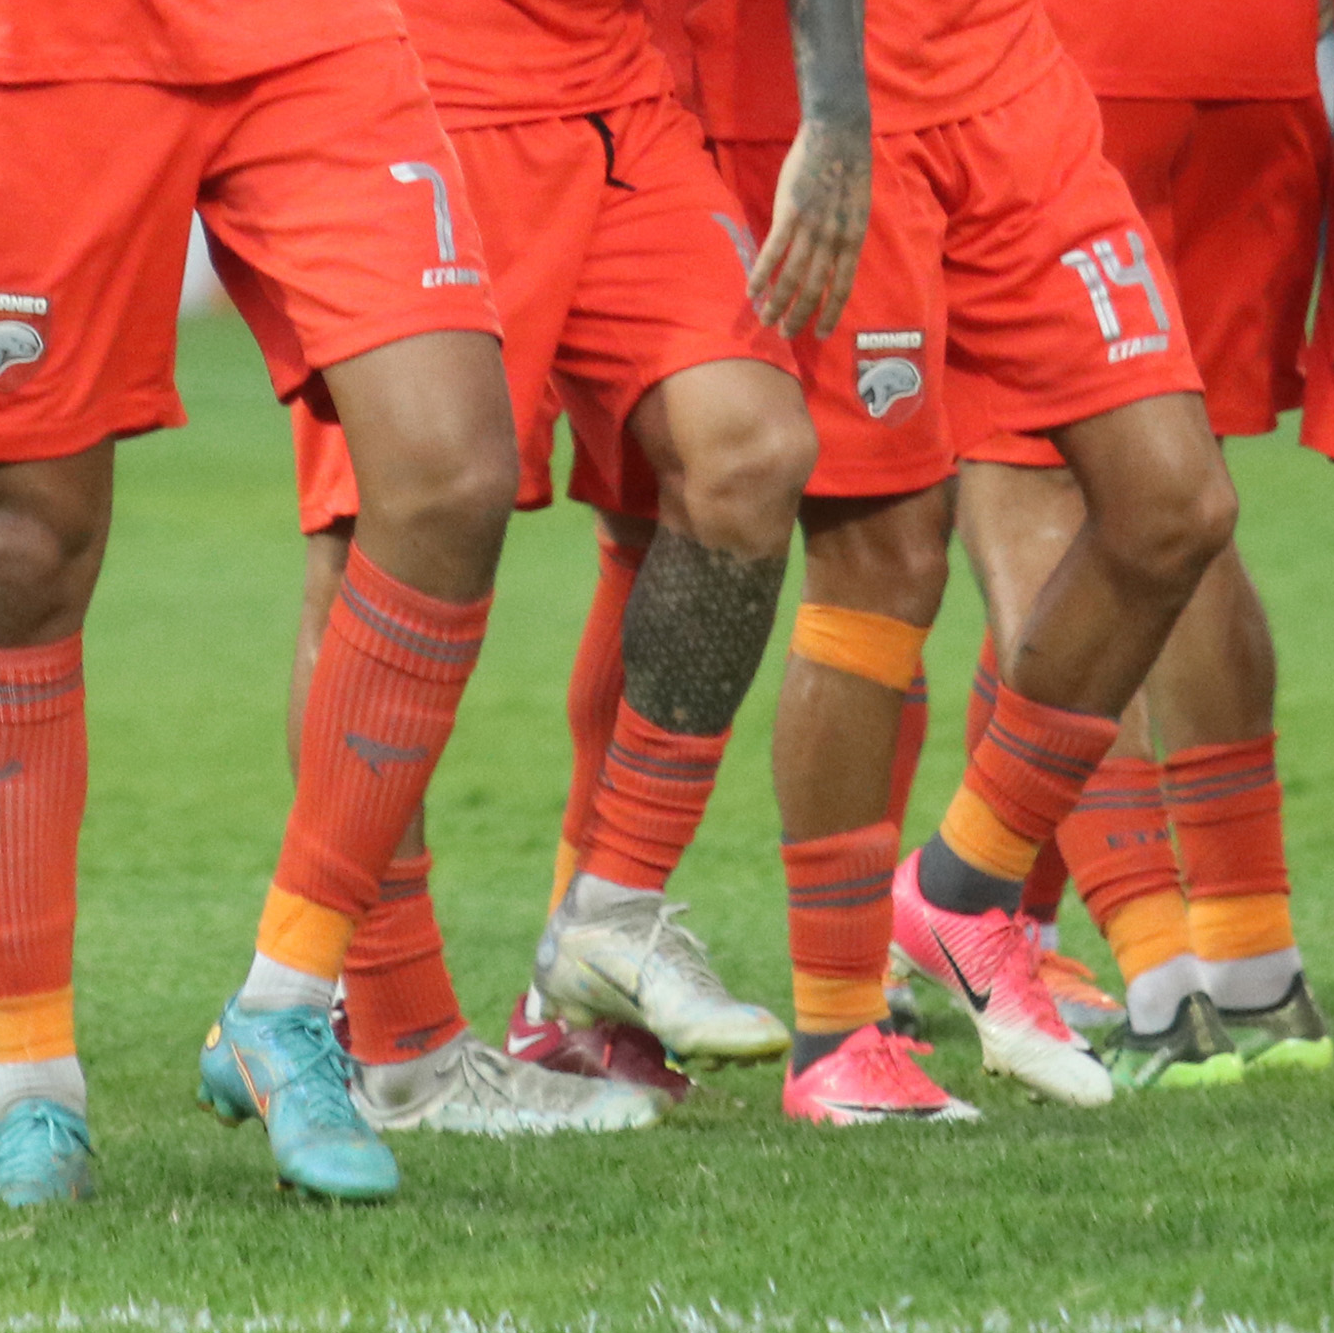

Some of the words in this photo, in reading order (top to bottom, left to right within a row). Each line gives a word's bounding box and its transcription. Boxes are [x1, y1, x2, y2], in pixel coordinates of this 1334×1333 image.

[388, 160, 457, 263] 7
[1059, 230, 1171, 343] 14
[856, 330, 923, 351] BORNEO
